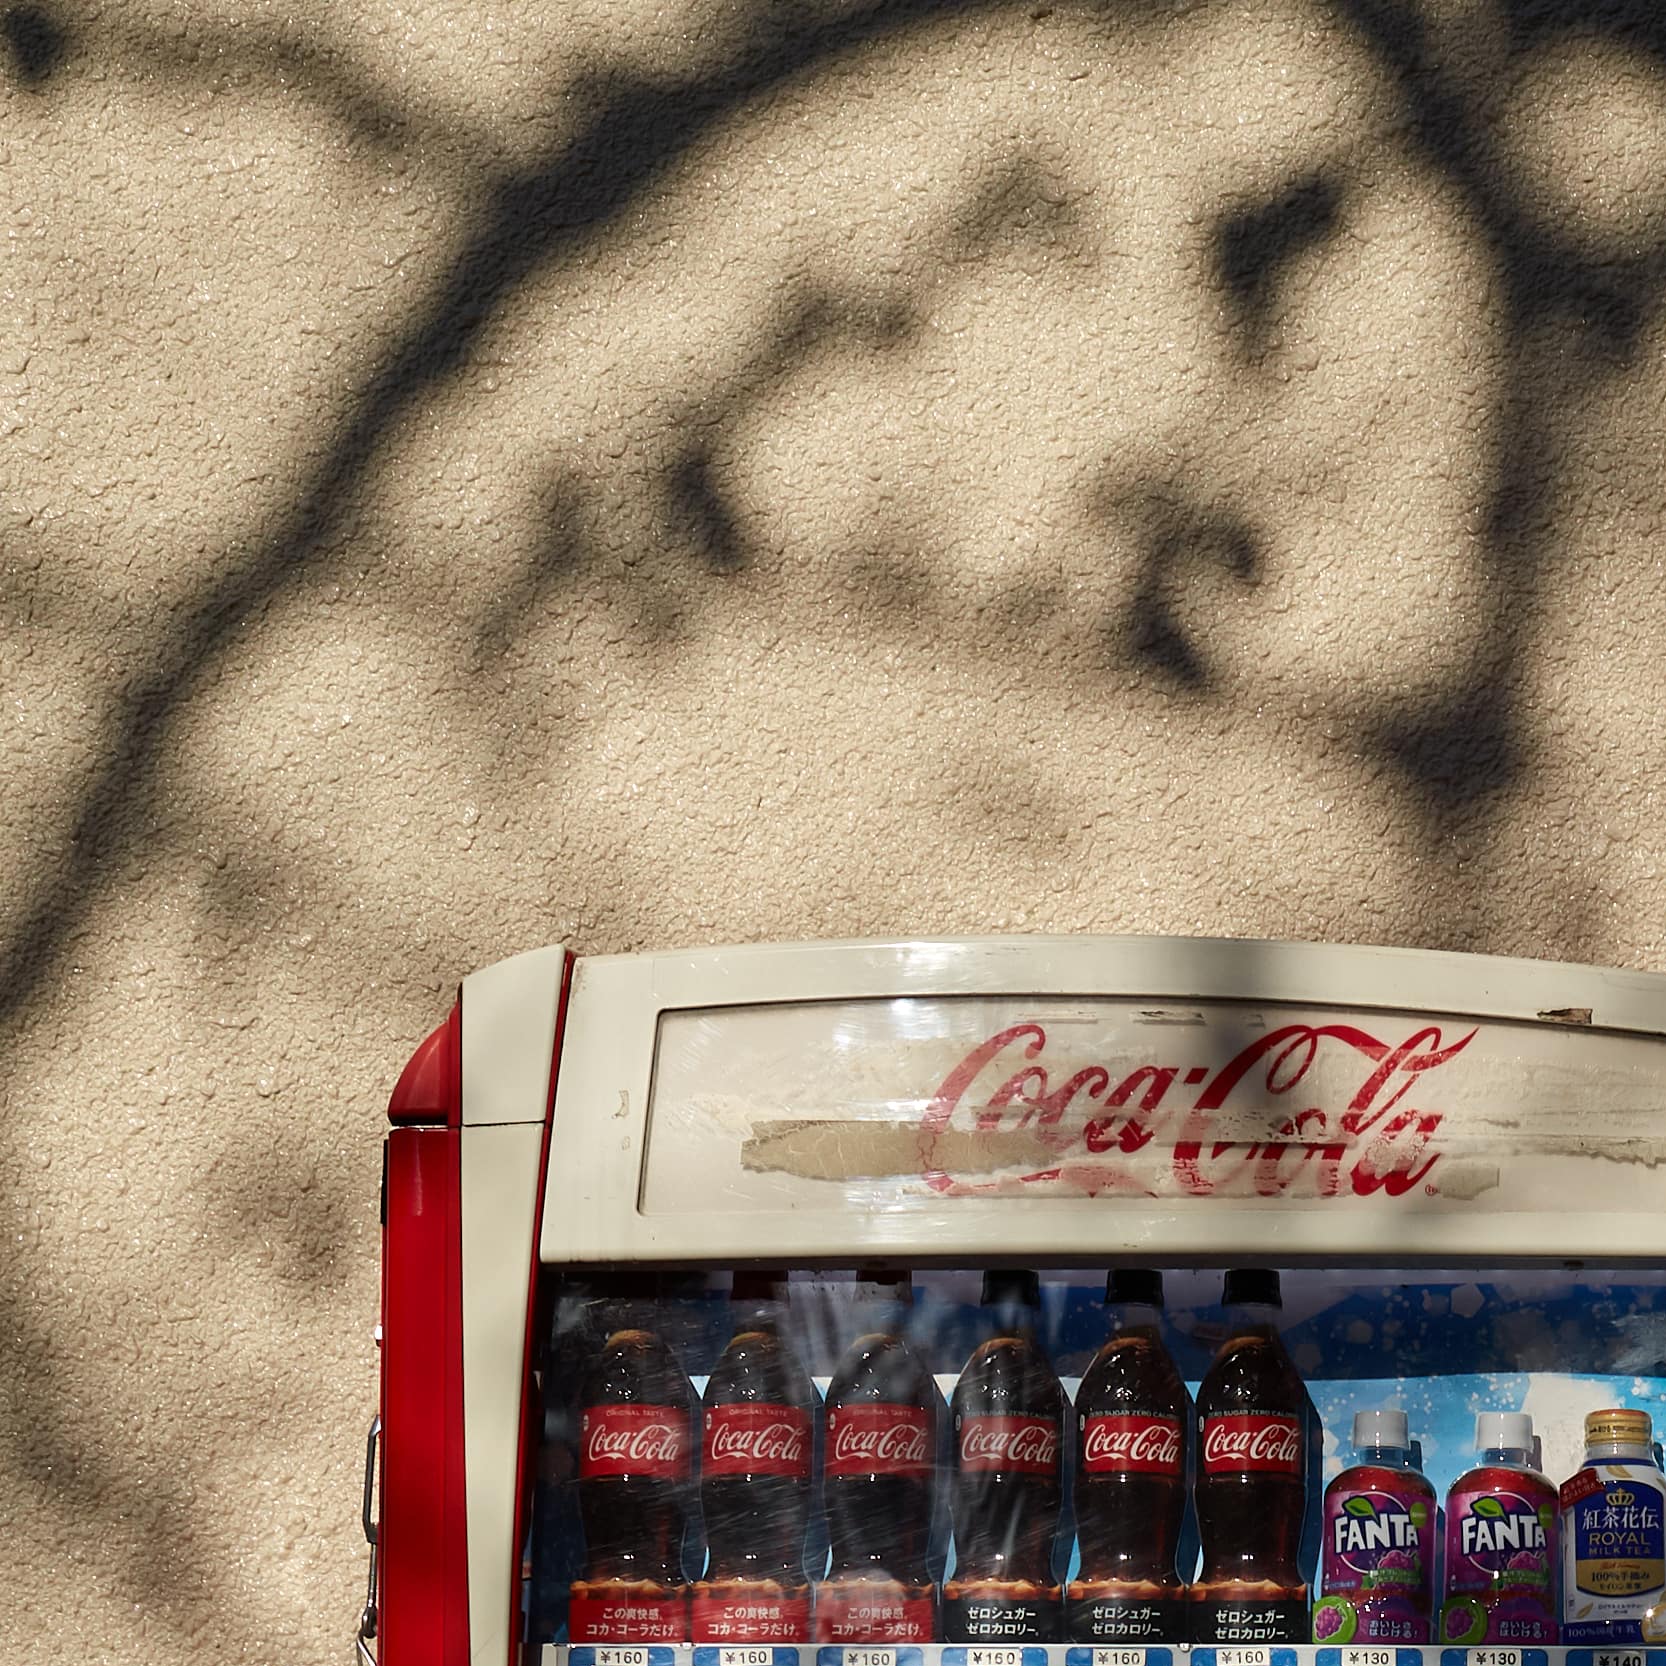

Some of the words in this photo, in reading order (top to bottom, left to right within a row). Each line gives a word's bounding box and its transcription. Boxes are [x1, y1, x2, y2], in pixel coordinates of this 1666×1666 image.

[921, 1022, 1478, 1198] Coca-Cola
[588, 1420, 680, 1463] Coca-Cola
[710, 1420, 801, 1463] Coca-Cola
[834, 1420, 927, 1463] Coca-Cola
[960, 1420, 1056, 1463] Coca-Cola
[1084, 1420, 1179, 1463] Coca-Cola
[1205, 1419, 1299, 1463] Coca-Cola
[1334, 1514, 1419, 1554] FANTA
[1462, 1516, 1547, 1556] FANTA
[1583, 1508, 1659, 1530] 紅茶花伝
[1589, 1532, 1650, 1546] ROYAL
[967, 1605, 1037, 1622] ゼロシュガー
[600, 1651, 643, 1664] ¥160
[1349, 1652, 1391, 1666] ¥130
